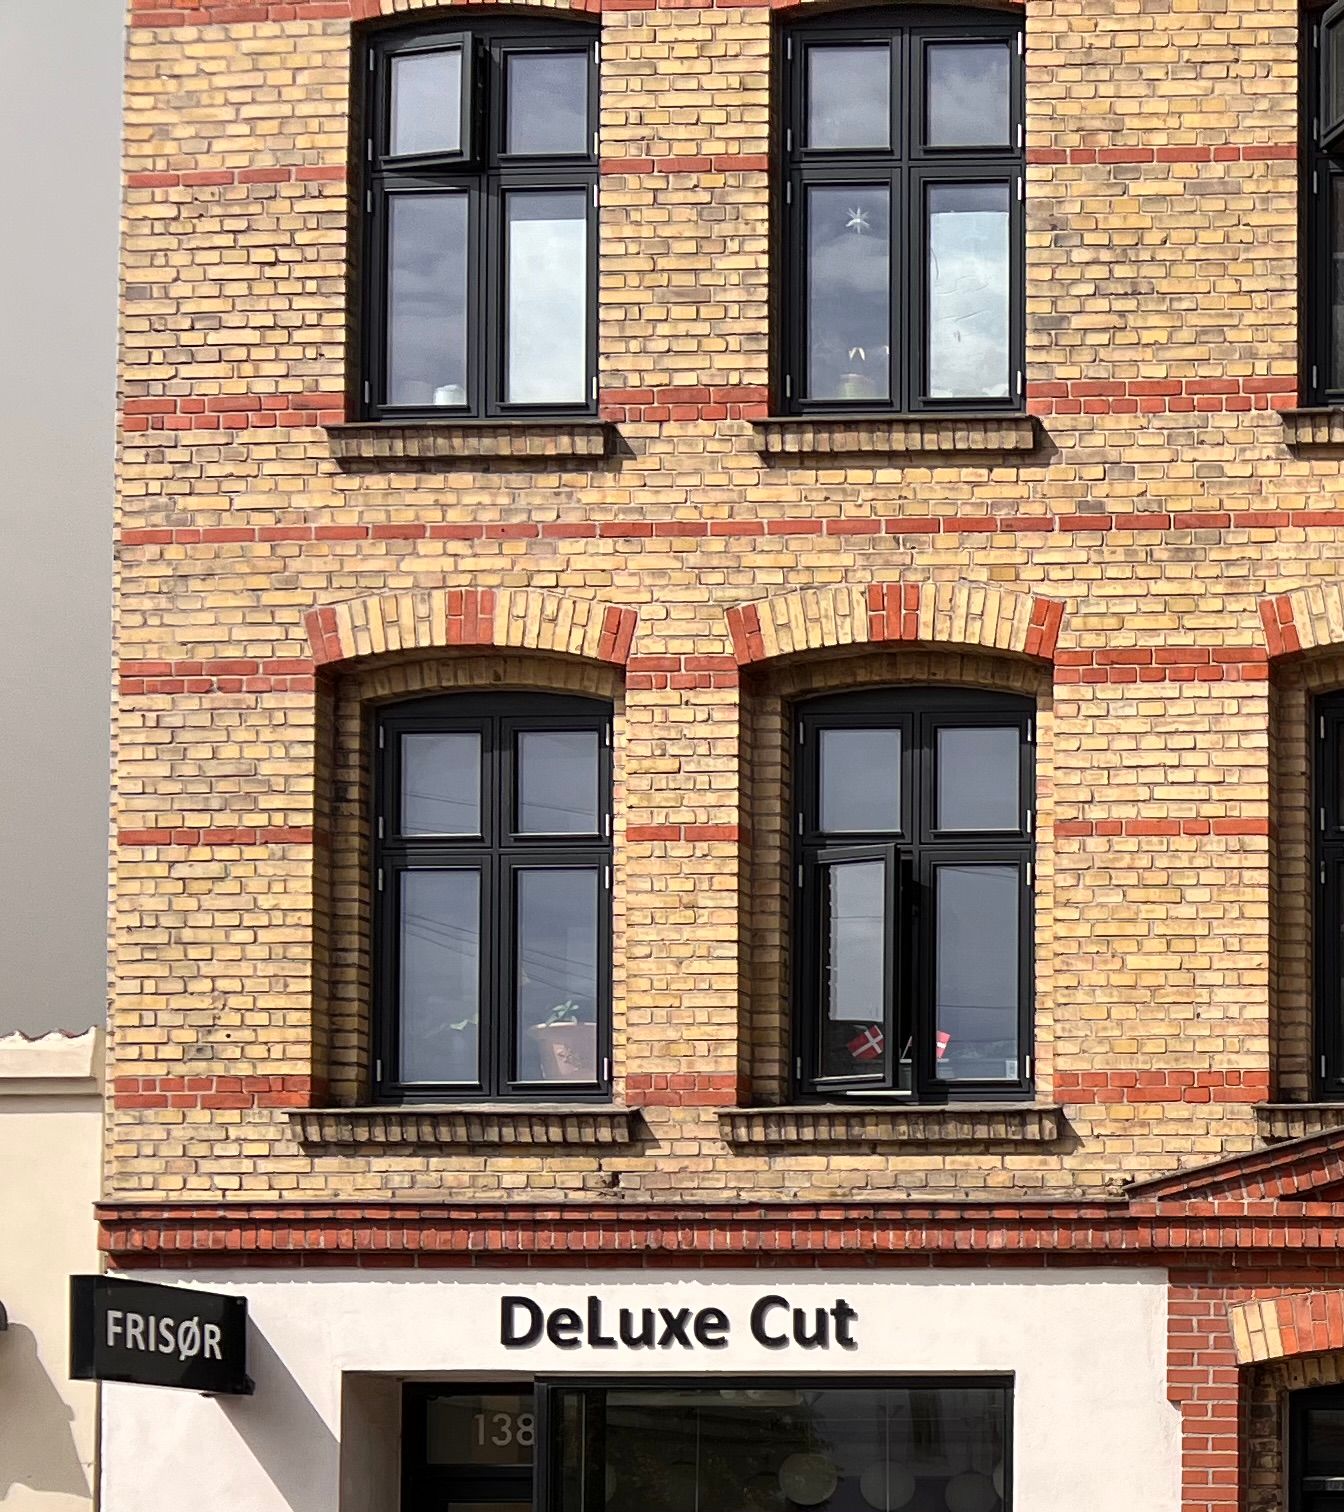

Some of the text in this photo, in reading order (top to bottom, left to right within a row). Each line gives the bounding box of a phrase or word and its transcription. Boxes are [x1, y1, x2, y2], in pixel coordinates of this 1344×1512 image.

[106, 1309, 222, 1361] FRISØR
[501, 1294, 855, 1346] DeLuxe Cut
[474, 1413, 536, 1446] 138
